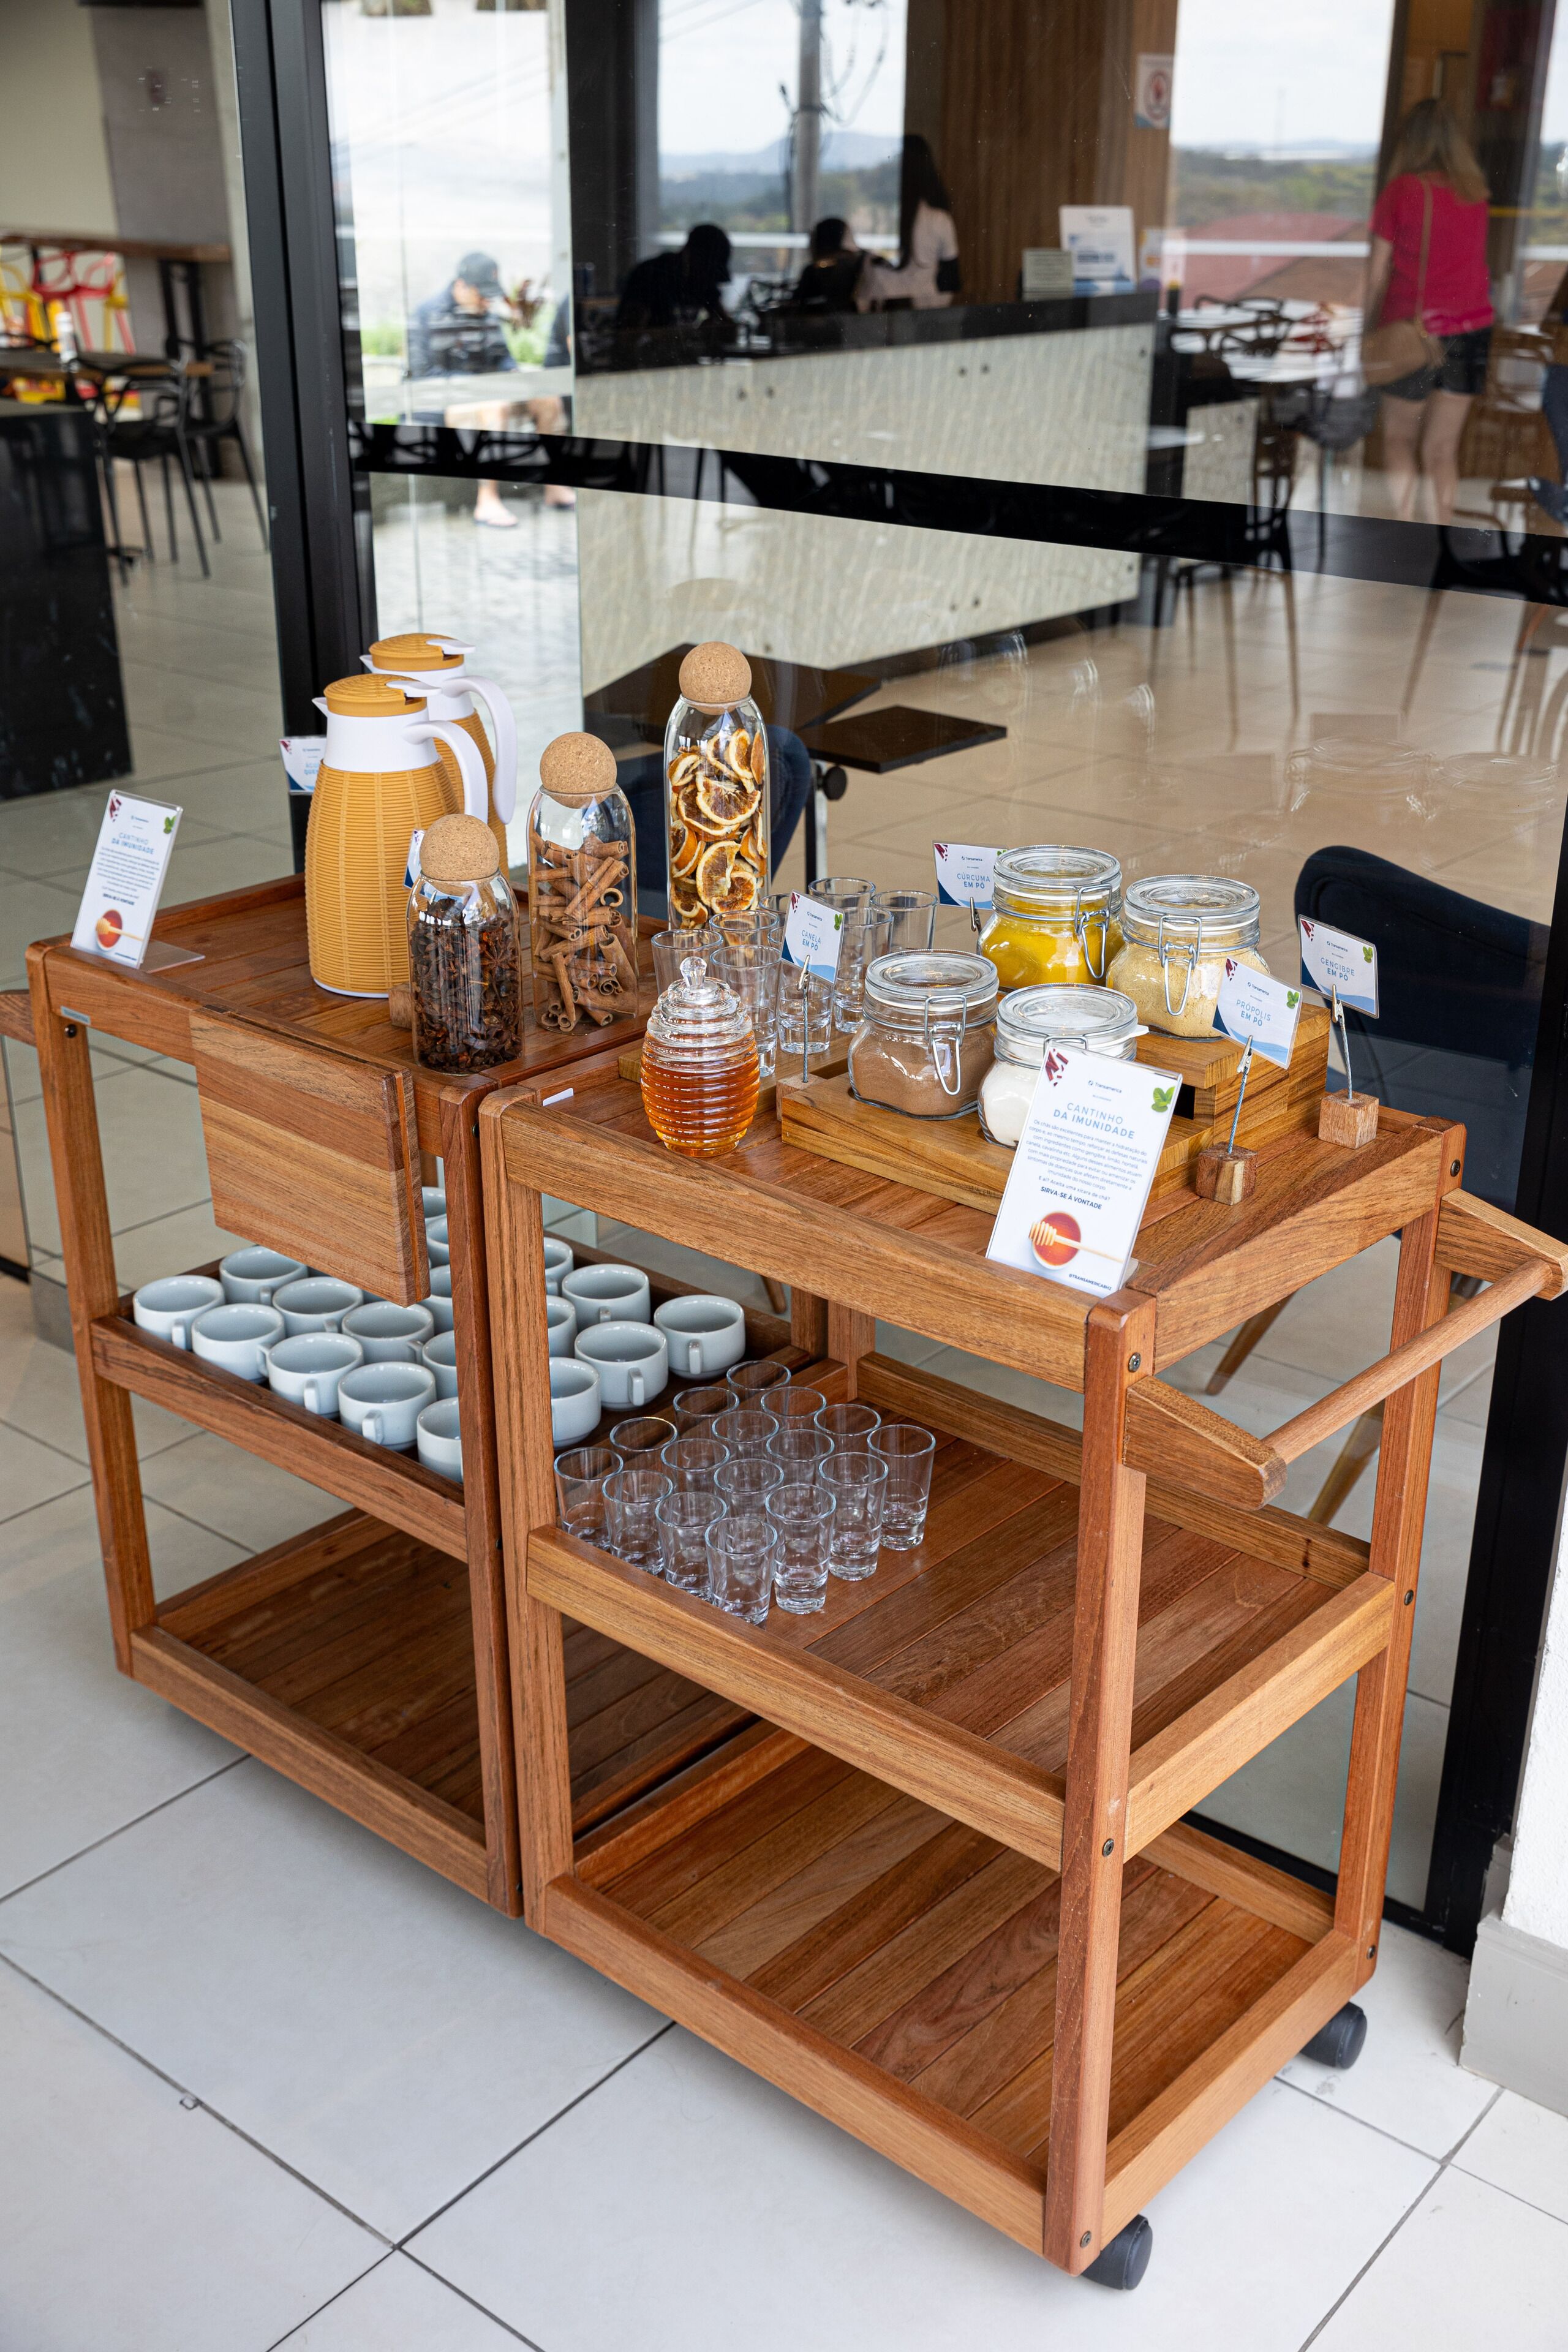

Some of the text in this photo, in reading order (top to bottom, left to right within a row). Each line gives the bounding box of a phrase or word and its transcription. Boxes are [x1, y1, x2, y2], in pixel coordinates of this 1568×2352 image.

[957, 873, 990, 882] CÚRCUMA
[802, 930, 821, 944] CANELA
[1321, 957, 1355, 976] GENGIBRE
[1236, 1000, 1272, 1022] PRÓPOLIS
[1241, 1011, 1251, 1021] EM
[1095, 1082, 1122, 1093] Transamerica
[1067, 1102, 1124, 1125] CANTINHO
[1054, 1109, 1135, 1139] DA IMUNIDADE
[1044, 1137, 1071, 1150] ingredientes
[1087, 1142, 1105, 1152] reforçar
[1111, 1149, 1128, 1158] defesas
[1129, 1155, 1148, 1164] naturais
[1095, 1137, 1112, 1145] manter
[1115, 1143, 1140, 1155] hidratação
[1042, 1144, 1063, 1154] cavalinha
[1072, 1153, 1088, 1163] Alguns
[1104, 1163, 1126, 1173] alimentos
[1050, 1153, 1077, 1166] propriedade
[1109, 1171, 1129, 1182] amenizar
[1028, 1155, 1047, 1164] sintomas
[1054, 1163, 1073, 1173] doenças
[1084, 1172, 1099, 1180] afetam
[1100, 1177, 1128, 1189] diretamente
[1048, 1169, 1071, 1179] imunidade
[1041, 1186, 1067, 1199] SIRVA-SE
[1074, 1196, 1102, 1209] VONTADE
[1069, 1273, 1112, 1290] @TRANSAMERICABHZ
